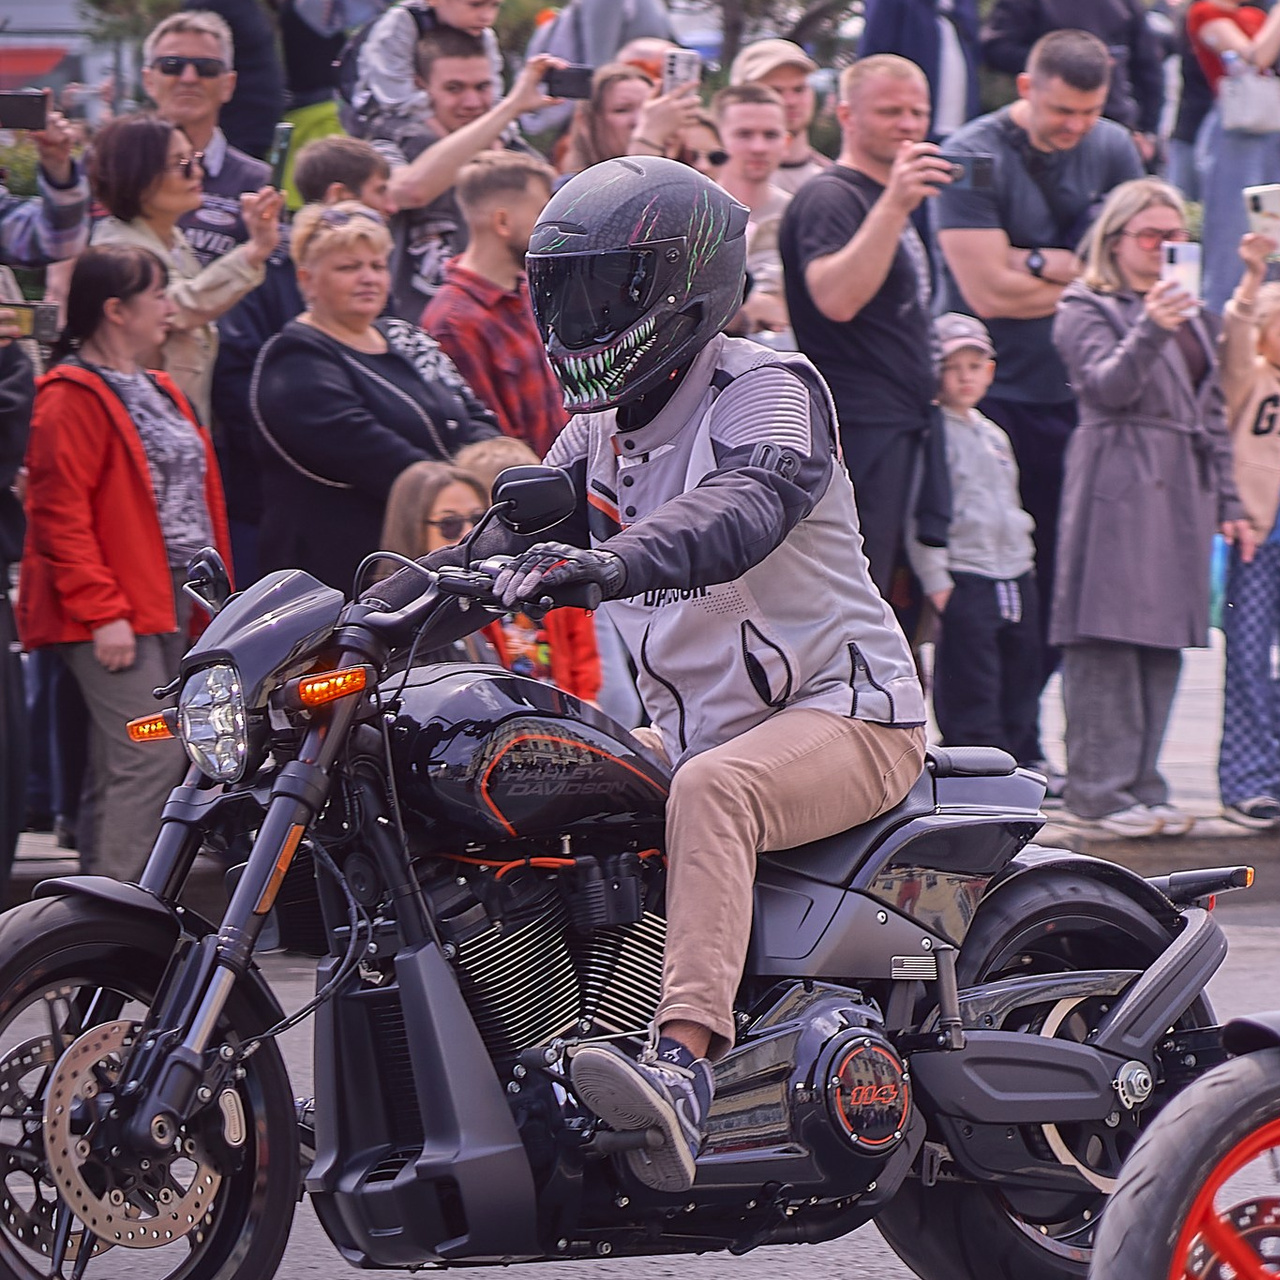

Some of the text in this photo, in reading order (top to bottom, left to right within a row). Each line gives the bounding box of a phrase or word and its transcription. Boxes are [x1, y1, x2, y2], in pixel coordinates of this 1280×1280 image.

[501, 766, 604, 782] HARLEY-
[506, 780, 627, 797] DAVIDSON
[850, 1084, 899, 1106] 114
